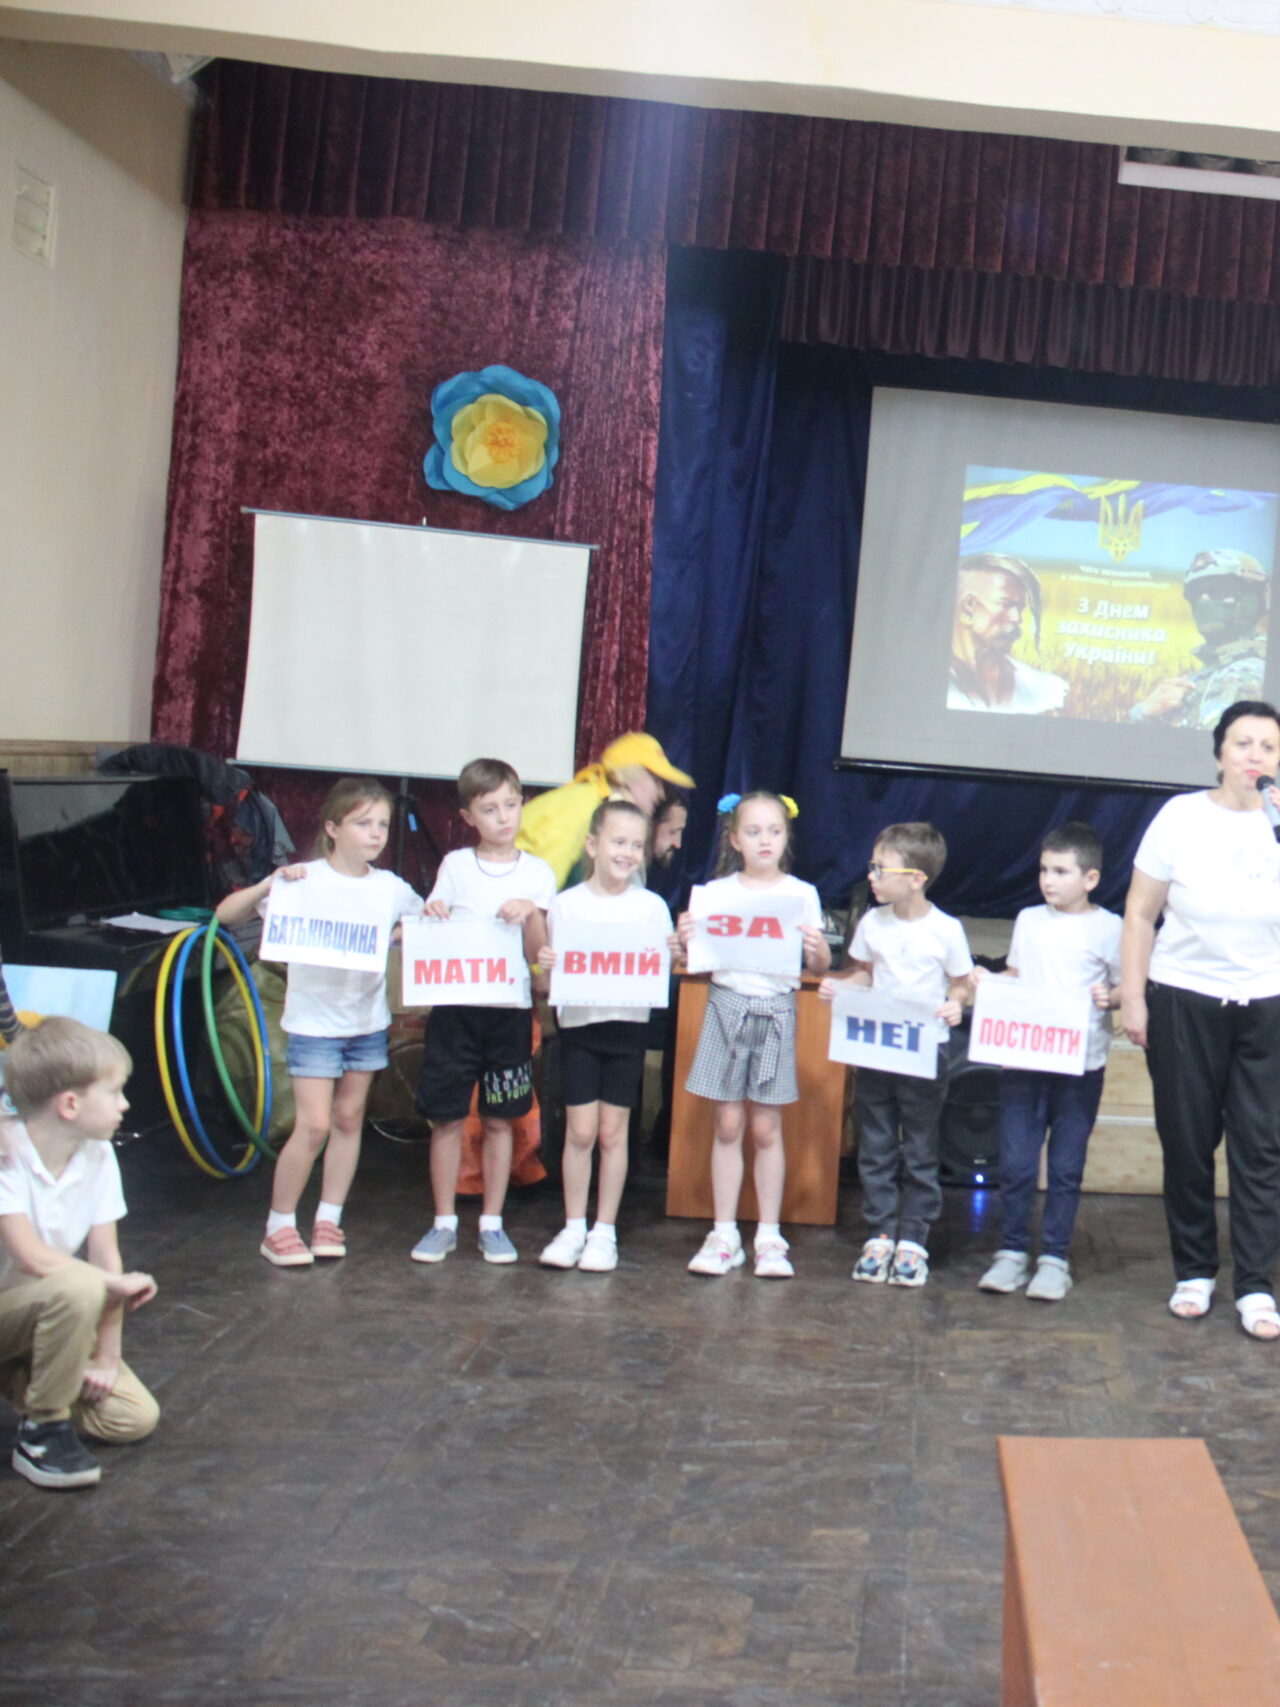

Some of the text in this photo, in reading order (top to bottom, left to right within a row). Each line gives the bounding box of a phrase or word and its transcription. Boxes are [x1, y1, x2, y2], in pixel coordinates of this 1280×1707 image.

[1077, 598, 1150, 620] З Днем
[267, 914, 379, 956] БАТЬКІВЩИНА
[706, 914, 785, 939] ЗА
[414, 958, 516, 985] МАТИ,
[563, 947, 662, 976] ВМІЙ
[846, 1015, 925, 1053] НЕЇ
[979, 1017, 1081, 1057] ПОСТОЯТИ
